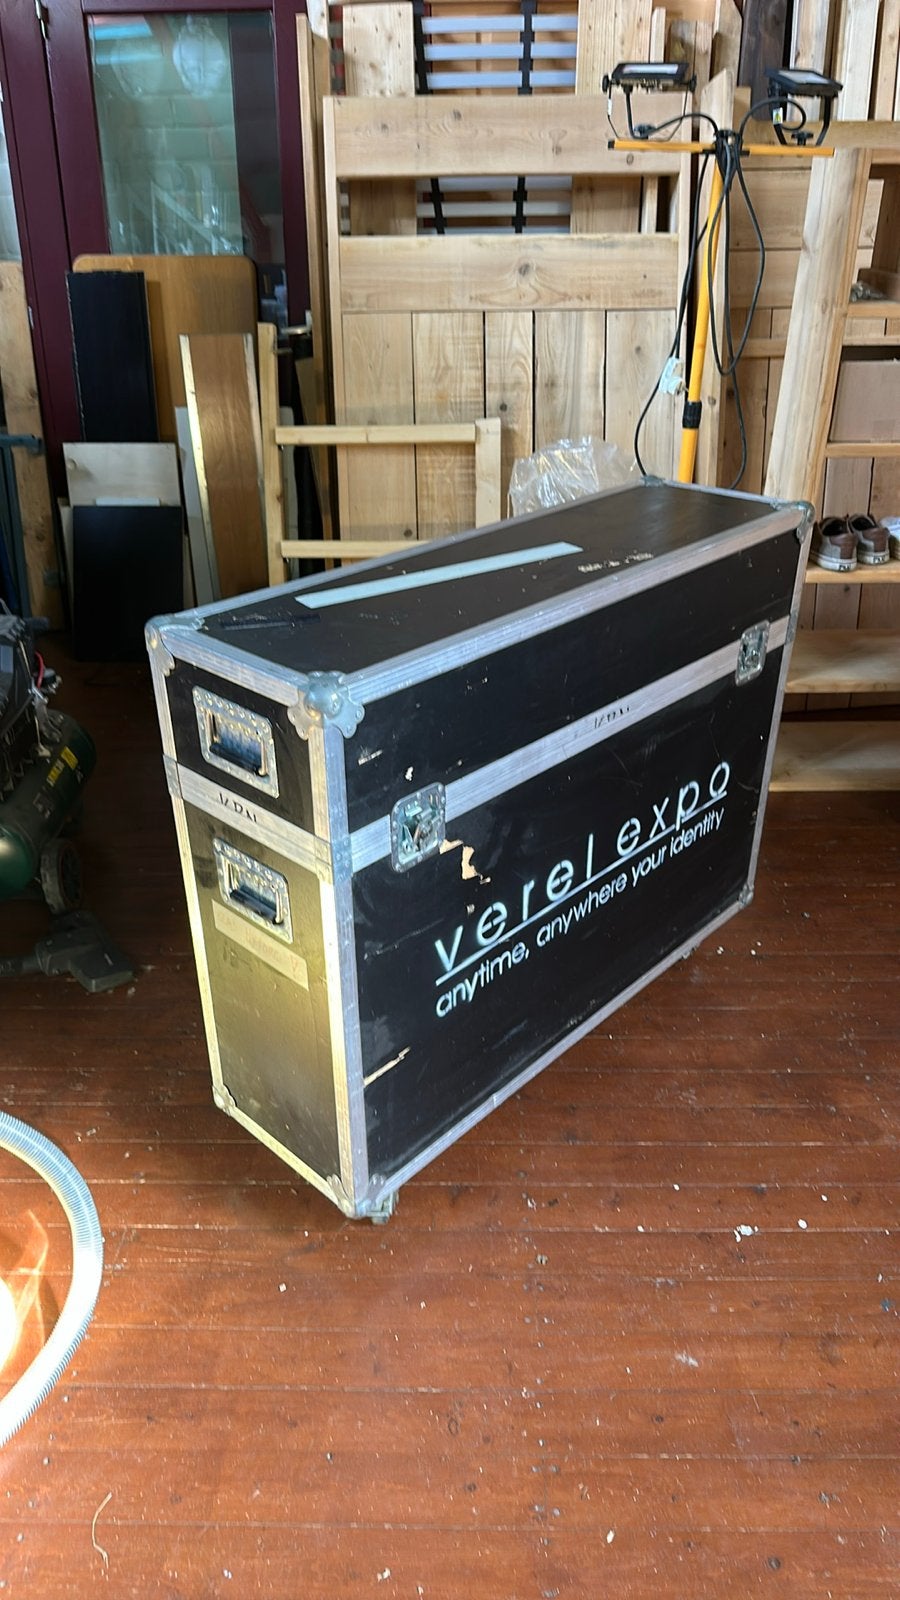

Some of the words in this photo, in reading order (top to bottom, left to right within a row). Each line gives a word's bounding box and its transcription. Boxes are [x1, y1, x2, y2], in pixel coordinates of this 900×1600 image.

[435, 833, 595, 971] verel
[616, 761, 731, 857] expo
[435, 941, 530, 1018] anytime,
[536, 871, 627, 947] anywhere
[631, 843, 667, 887] your
[669, 807, 725, 858] identity
